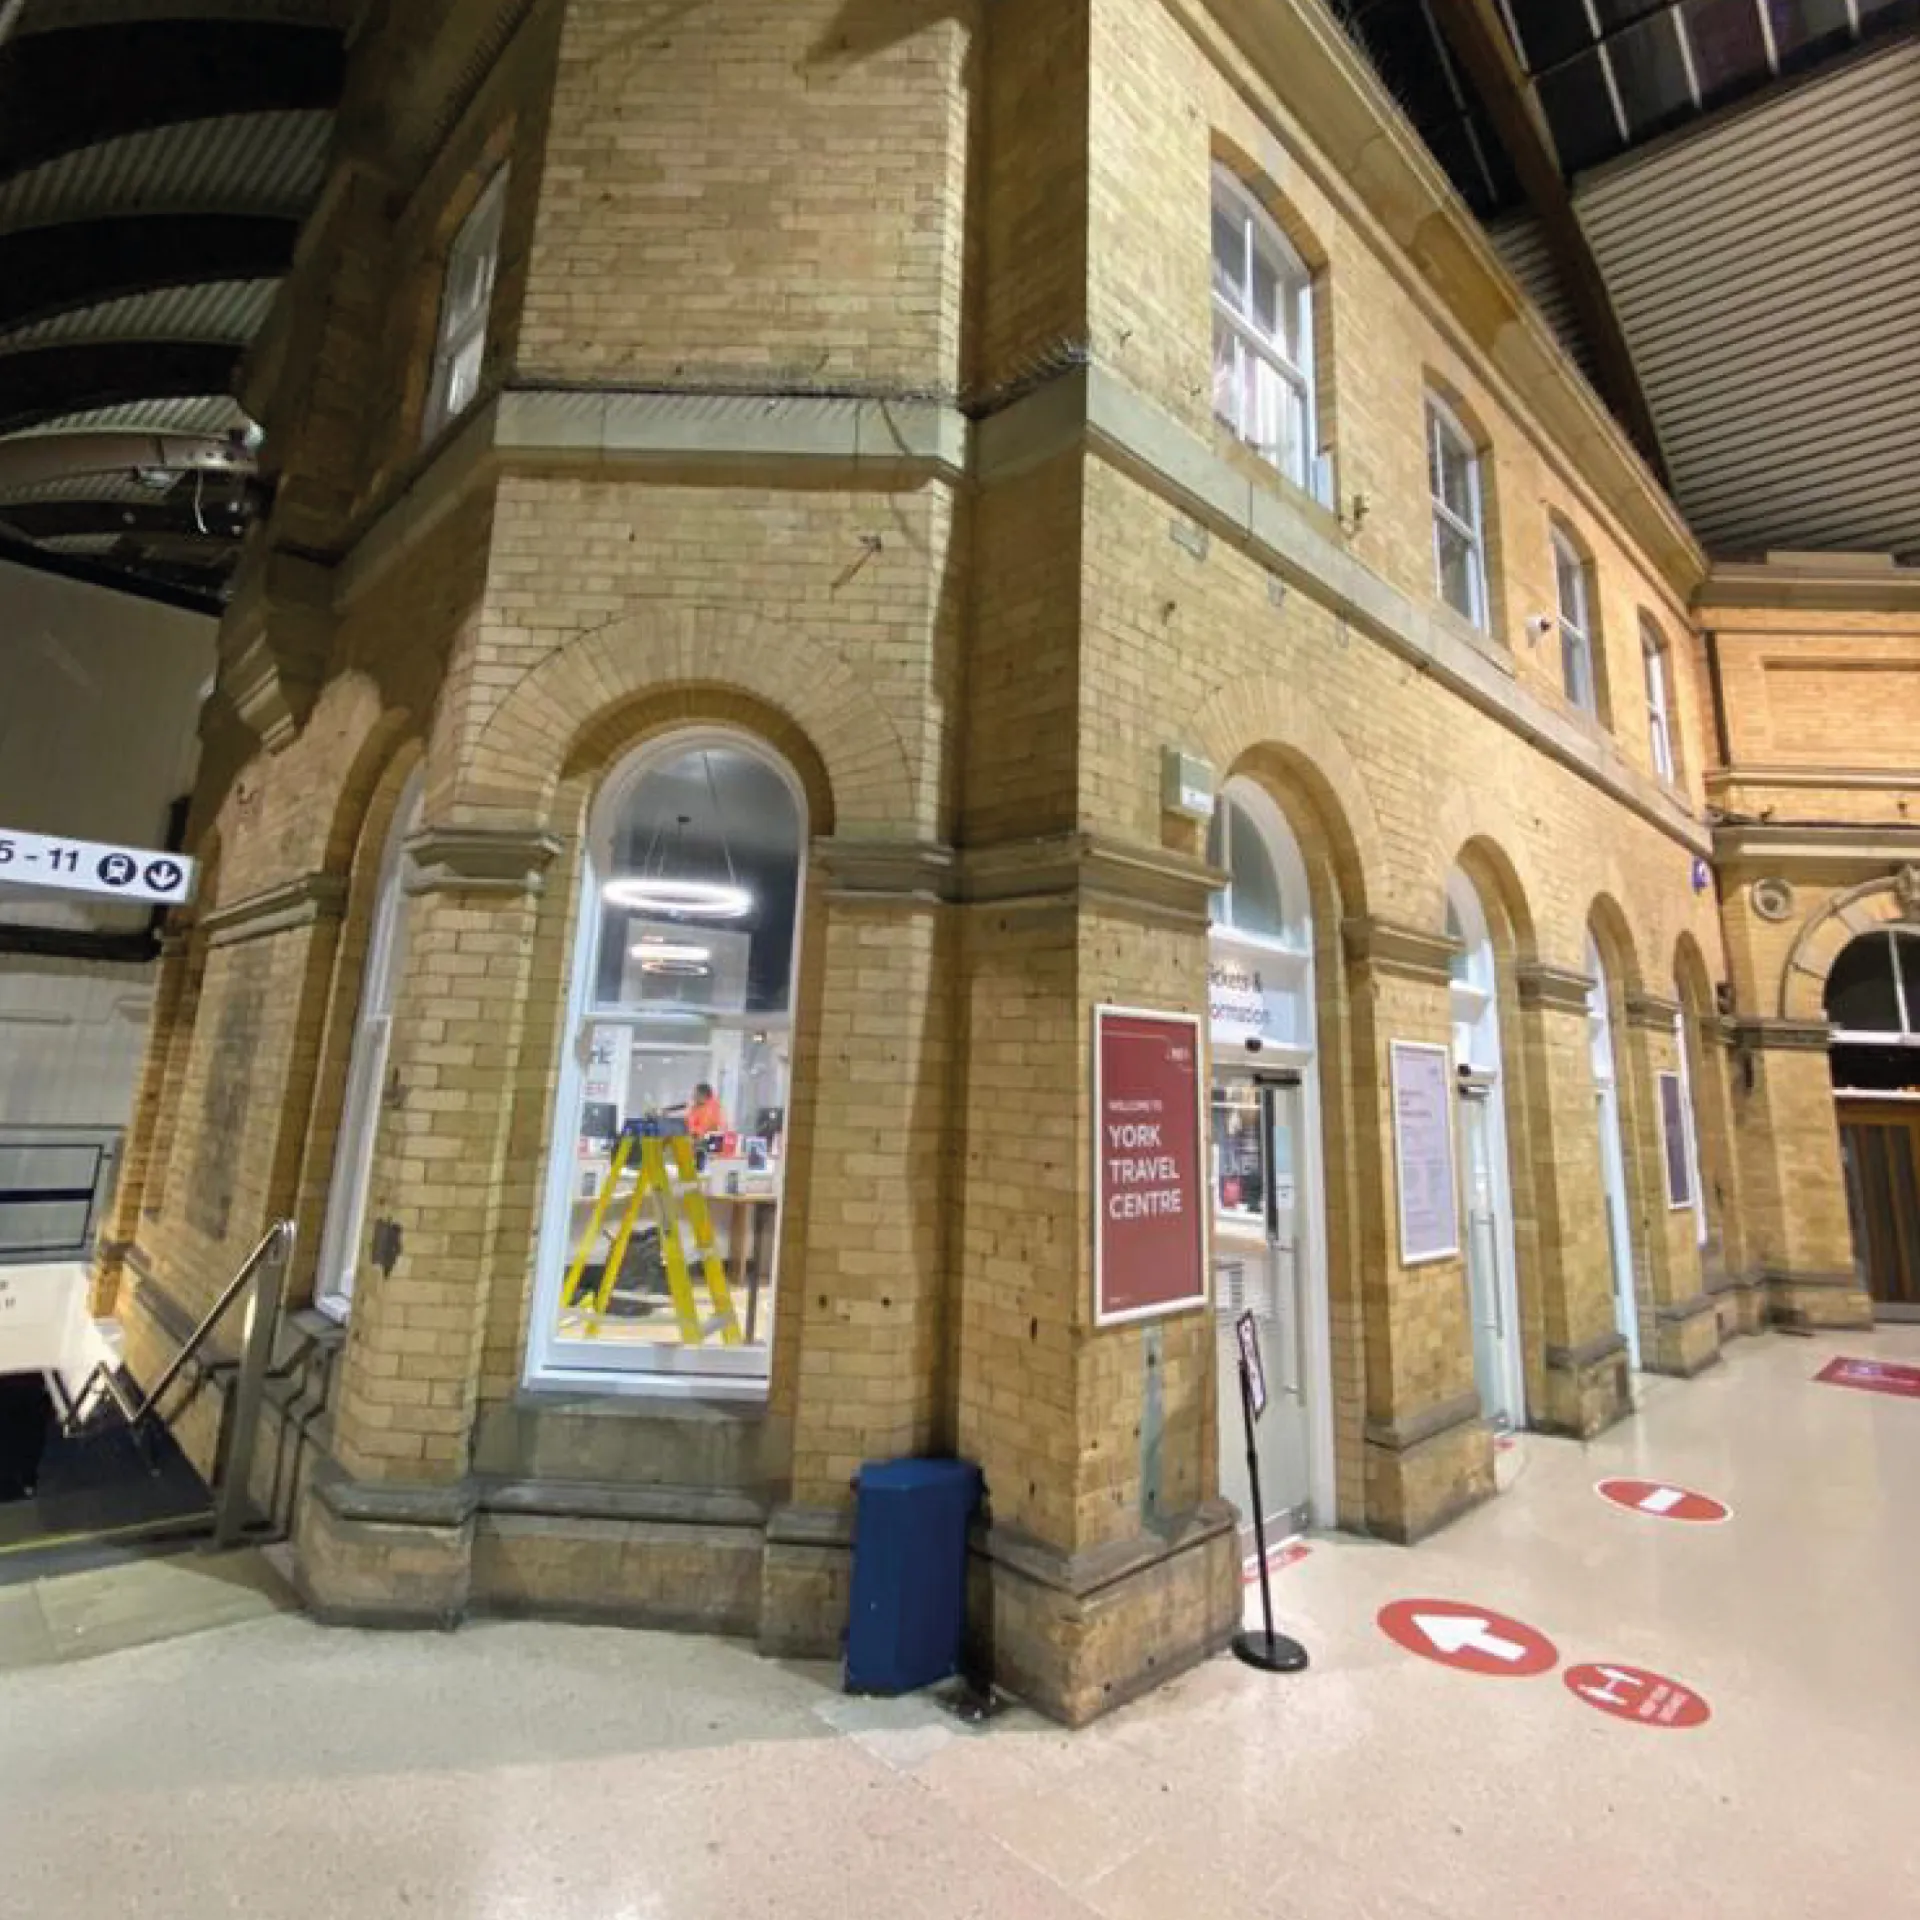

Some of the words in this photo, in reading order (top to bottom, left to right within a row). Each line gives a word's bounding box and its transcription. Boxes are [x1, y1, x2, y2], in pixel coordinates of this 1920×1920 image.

[48, 848, 78, 872] 11
[1108, 1123, 1161, 1149] YORK
[1108, 1156, 1180, 1184] TRAVEL
[1109, 1188, 1183, 1220] CENTRE
